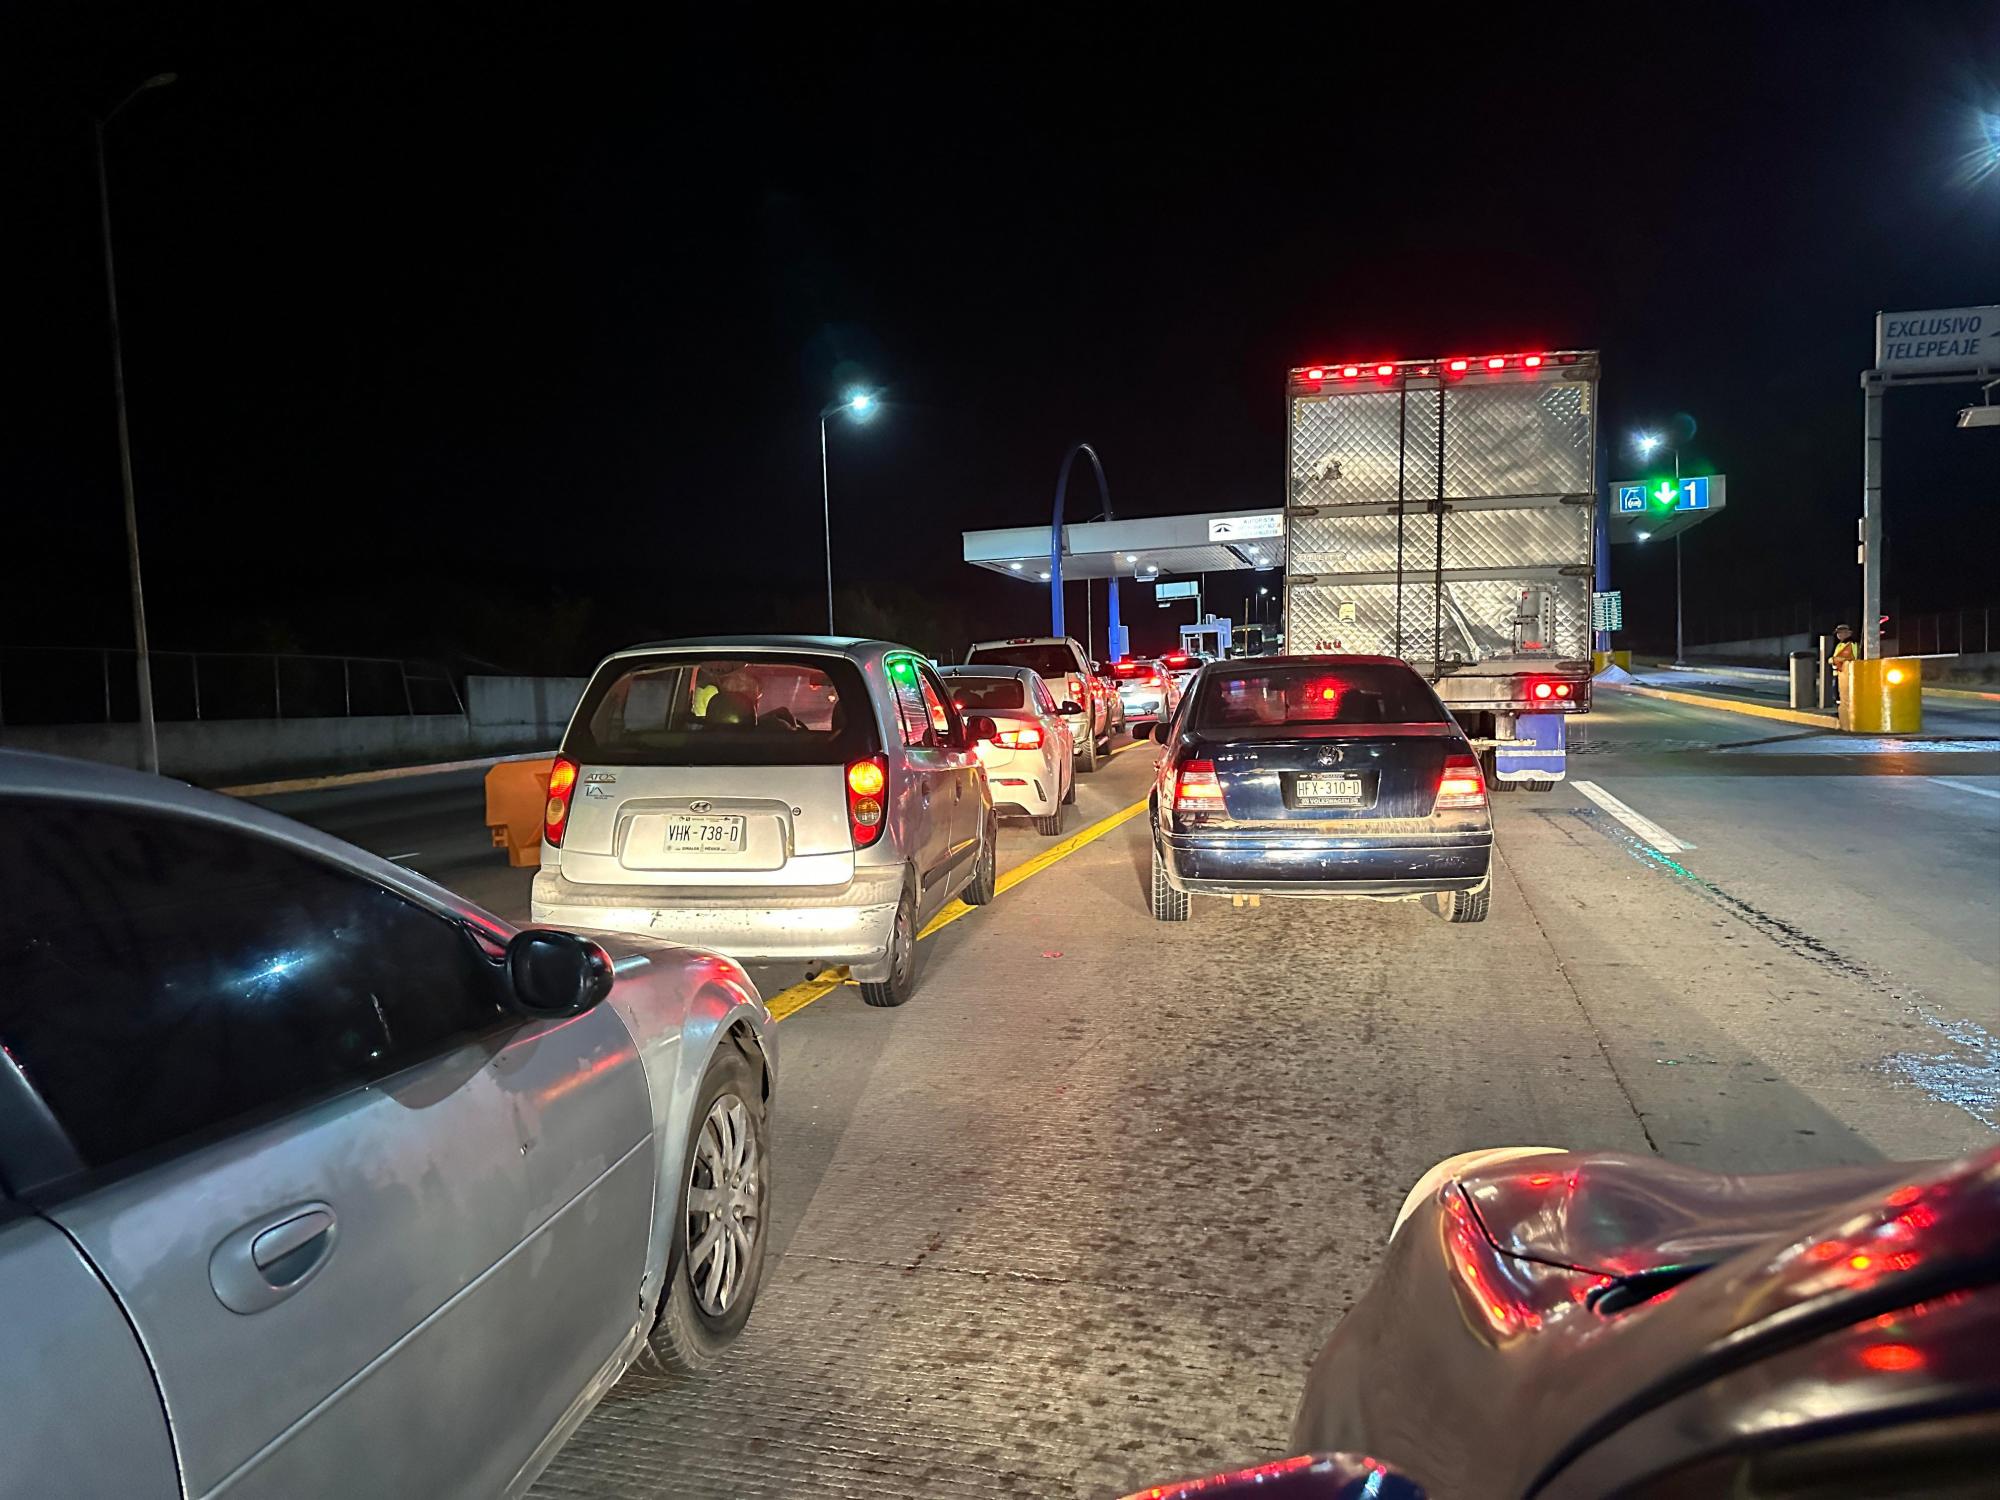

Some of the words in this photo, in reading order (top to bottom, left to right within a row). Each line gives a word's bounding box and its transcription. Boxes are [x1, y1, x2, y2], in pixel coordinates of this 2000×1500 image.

[1886, 316, 1982, 338] EXCLUSIVO
[1886, 338, 1981, 360] TELEPEAJE
[1684, 481, 1696, 506] 1
[585, 773, 616, 781] ATOS
[1298, 781, 1360, 796] HFX-310-D
[669, 825, 739, 841] VHK-738-D
